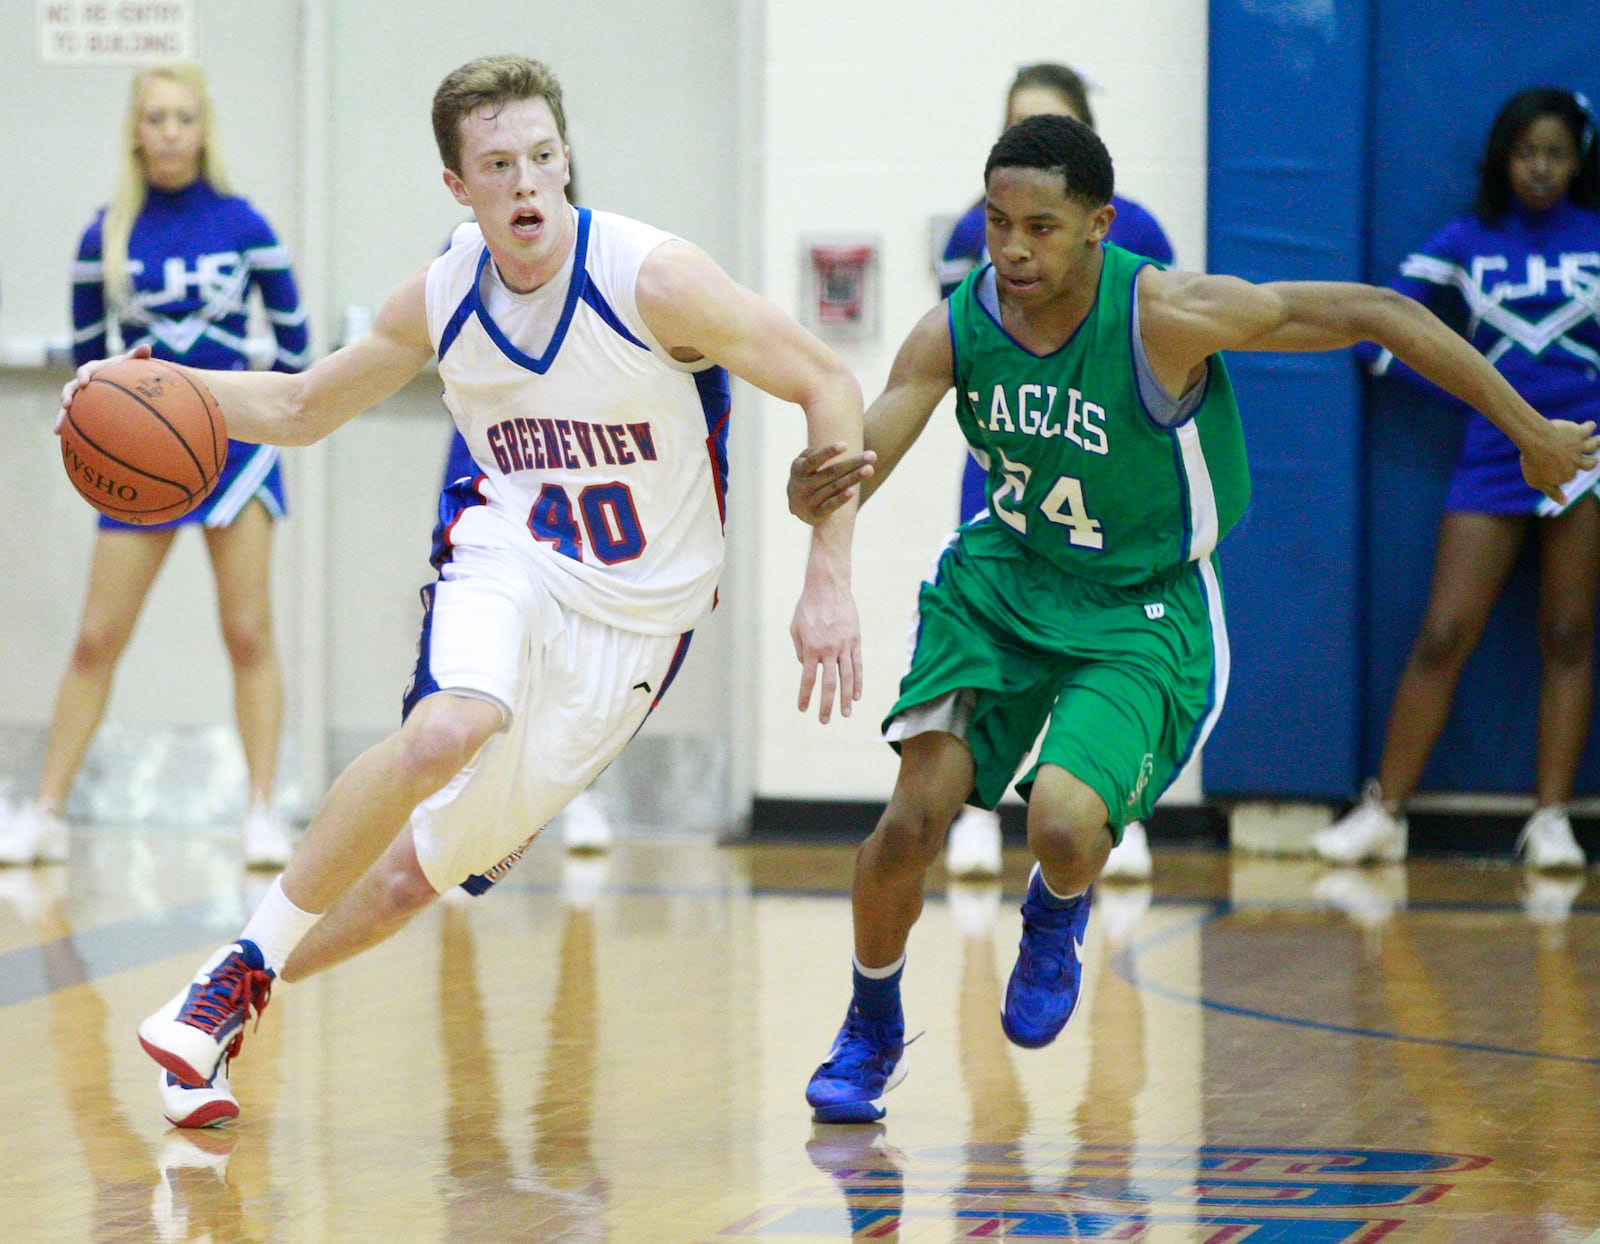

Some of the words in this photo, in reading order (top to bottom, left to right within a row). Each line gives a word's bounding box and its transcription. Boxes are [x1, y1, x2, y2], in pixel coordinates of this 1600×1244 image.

[47, 4, 74, 23] NO
[55, 32, 78, 52] TO
[487, 417, 658, 475] GREENEVIEW
[526, 480, 648, 566] 40
[991, 446, 1104, 550] 24
